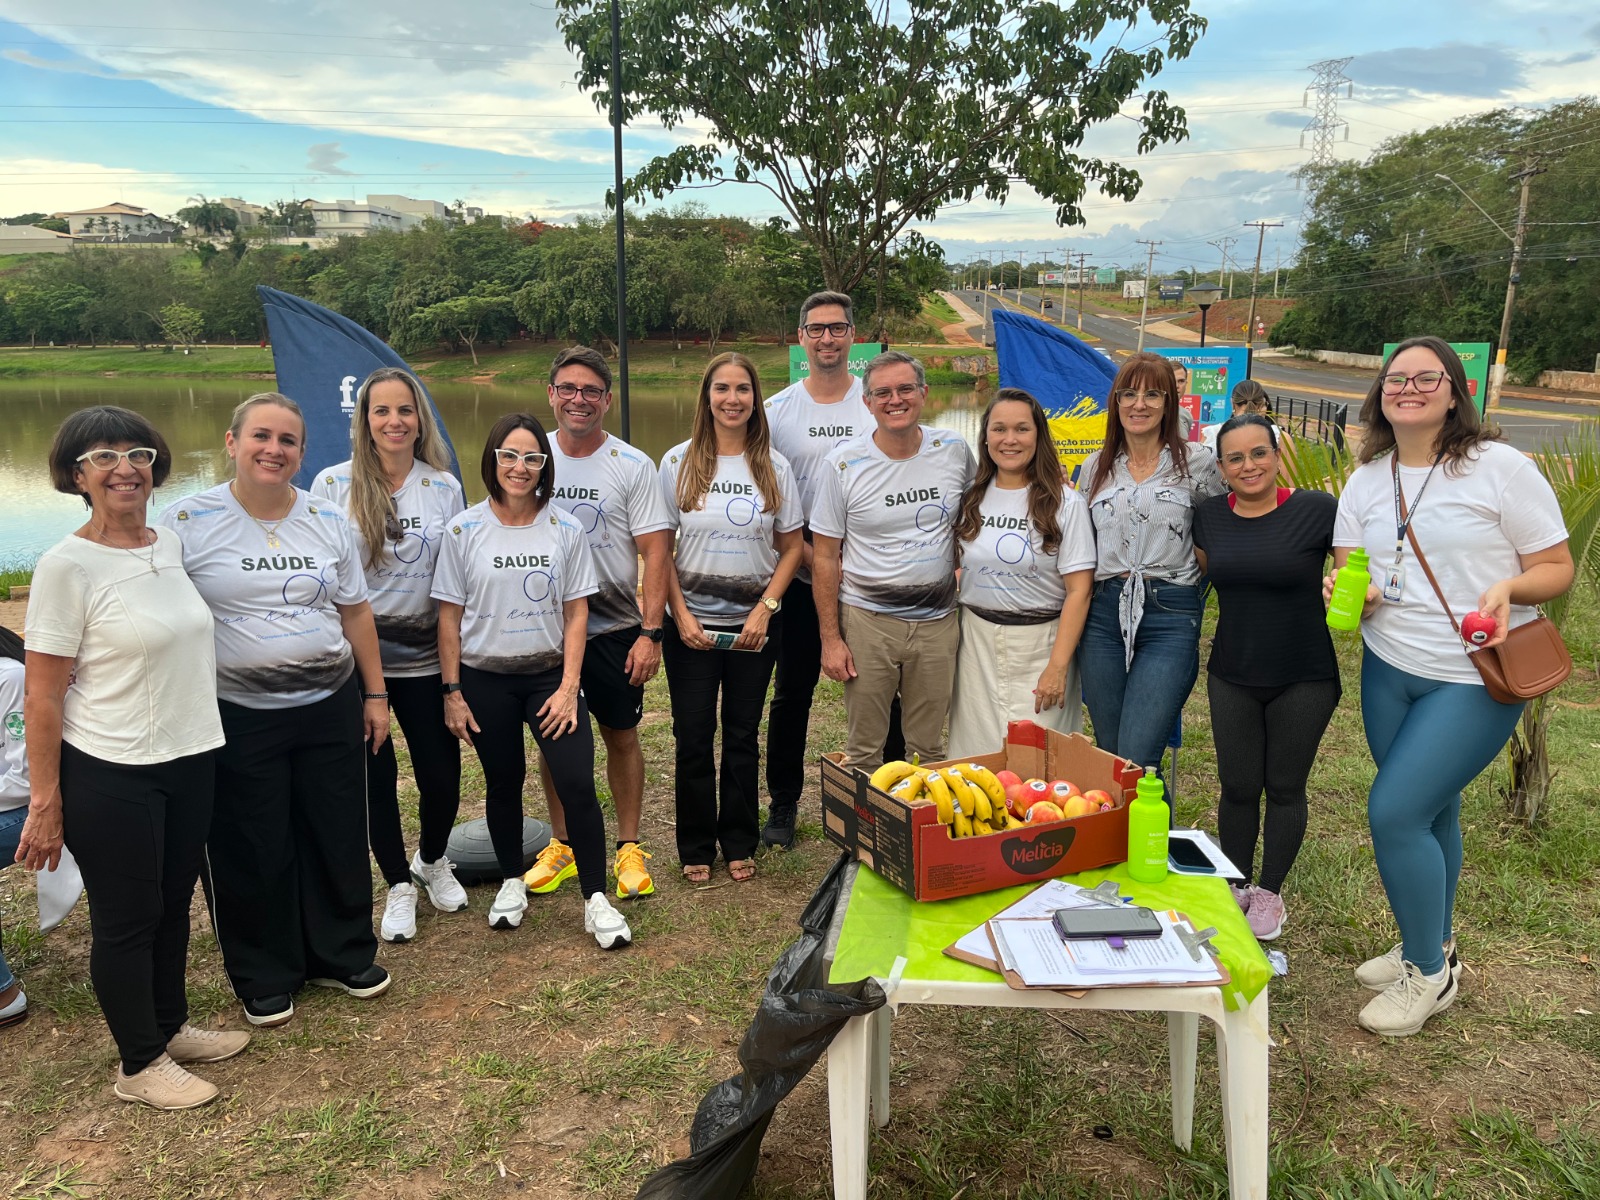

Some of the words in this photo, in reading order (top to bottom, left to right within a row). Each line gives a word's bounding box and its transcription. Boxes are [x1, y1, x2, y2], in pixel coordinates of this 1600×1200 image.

[808, 424, 853, 437] SAÚDE
[1059, 447, 1099, 455] FERNAND
[884, 487, 941, 507] SAÚDE
[241, 553, 318, 572] SAÚDE
[493, 553, 550, 569] SAÚDE
